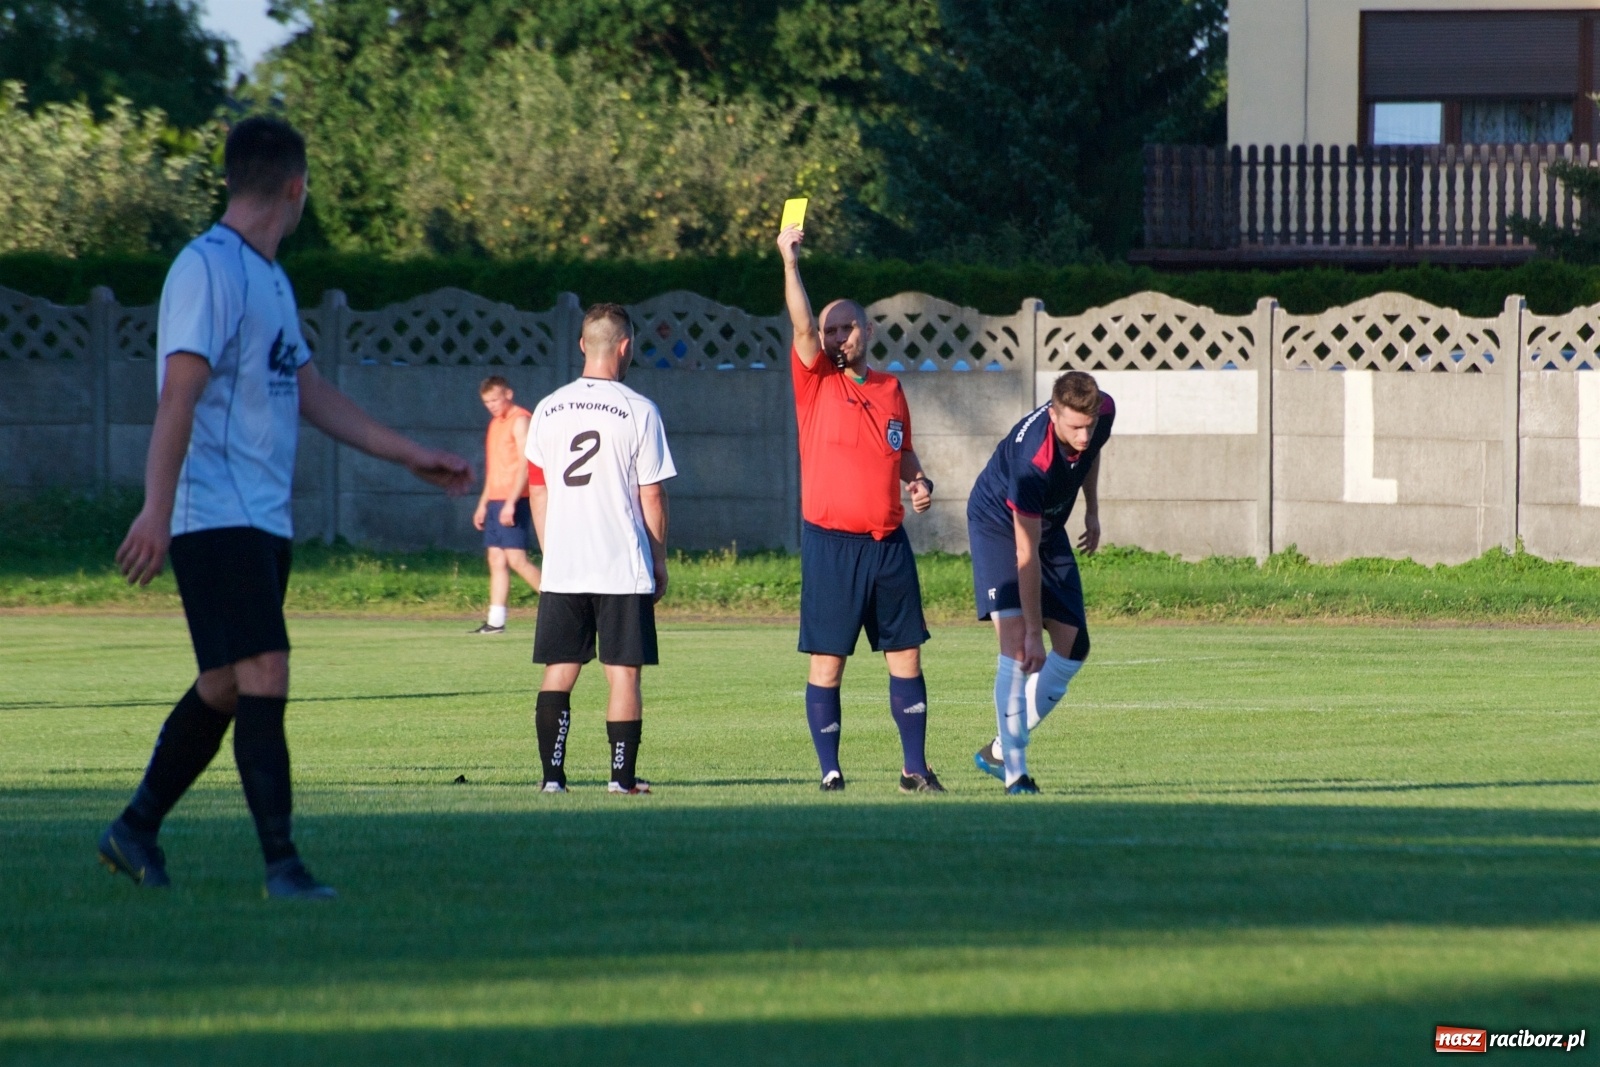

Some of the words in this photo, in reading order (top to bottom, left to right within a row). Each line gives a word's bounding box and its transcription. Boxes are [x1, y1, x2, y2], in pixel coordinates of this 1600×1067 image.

[545, 402, 565, 417] LKS
[568, 402, 629, 419] TWORKÓW
[1344, 370, 1398, 504] L
[563, 430, 600, 487] 2
